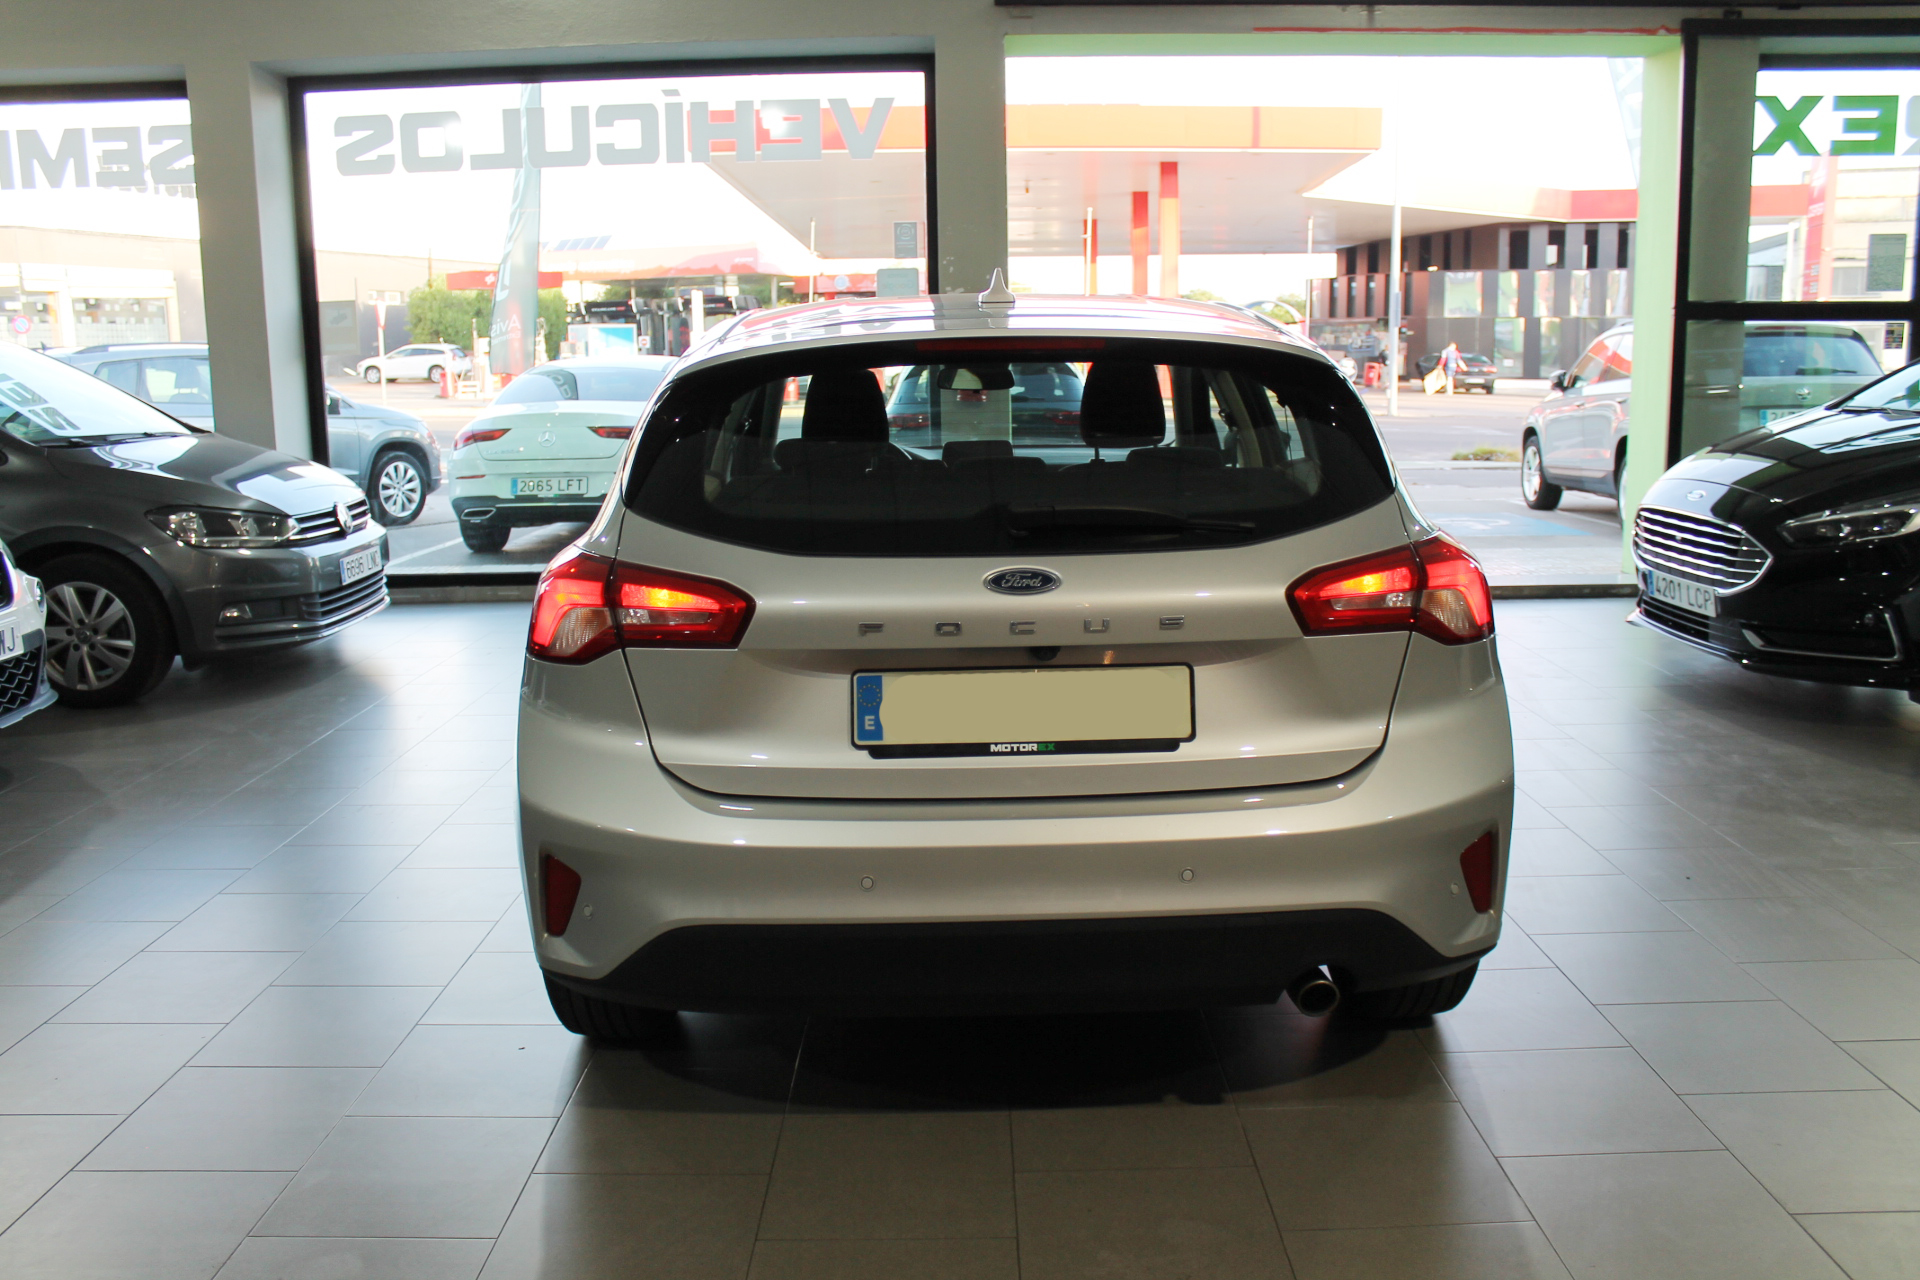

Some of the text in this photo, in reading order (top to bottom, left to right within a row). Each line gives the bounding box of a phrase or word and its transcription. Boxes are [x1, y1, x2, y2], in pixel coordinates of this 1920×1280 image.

[519, 478, 583, 493] 2065 LFT
[345, 556, 365, 579] 6696
[1001, 572, 1042, 588] Ford
[1656, 576, 1711, 611] 4201 LCP
[858, 614, 1185, 636] FOCUS
[864, 715, 875, 730] E
[990, 743, 1055, 753] MOTOREX
